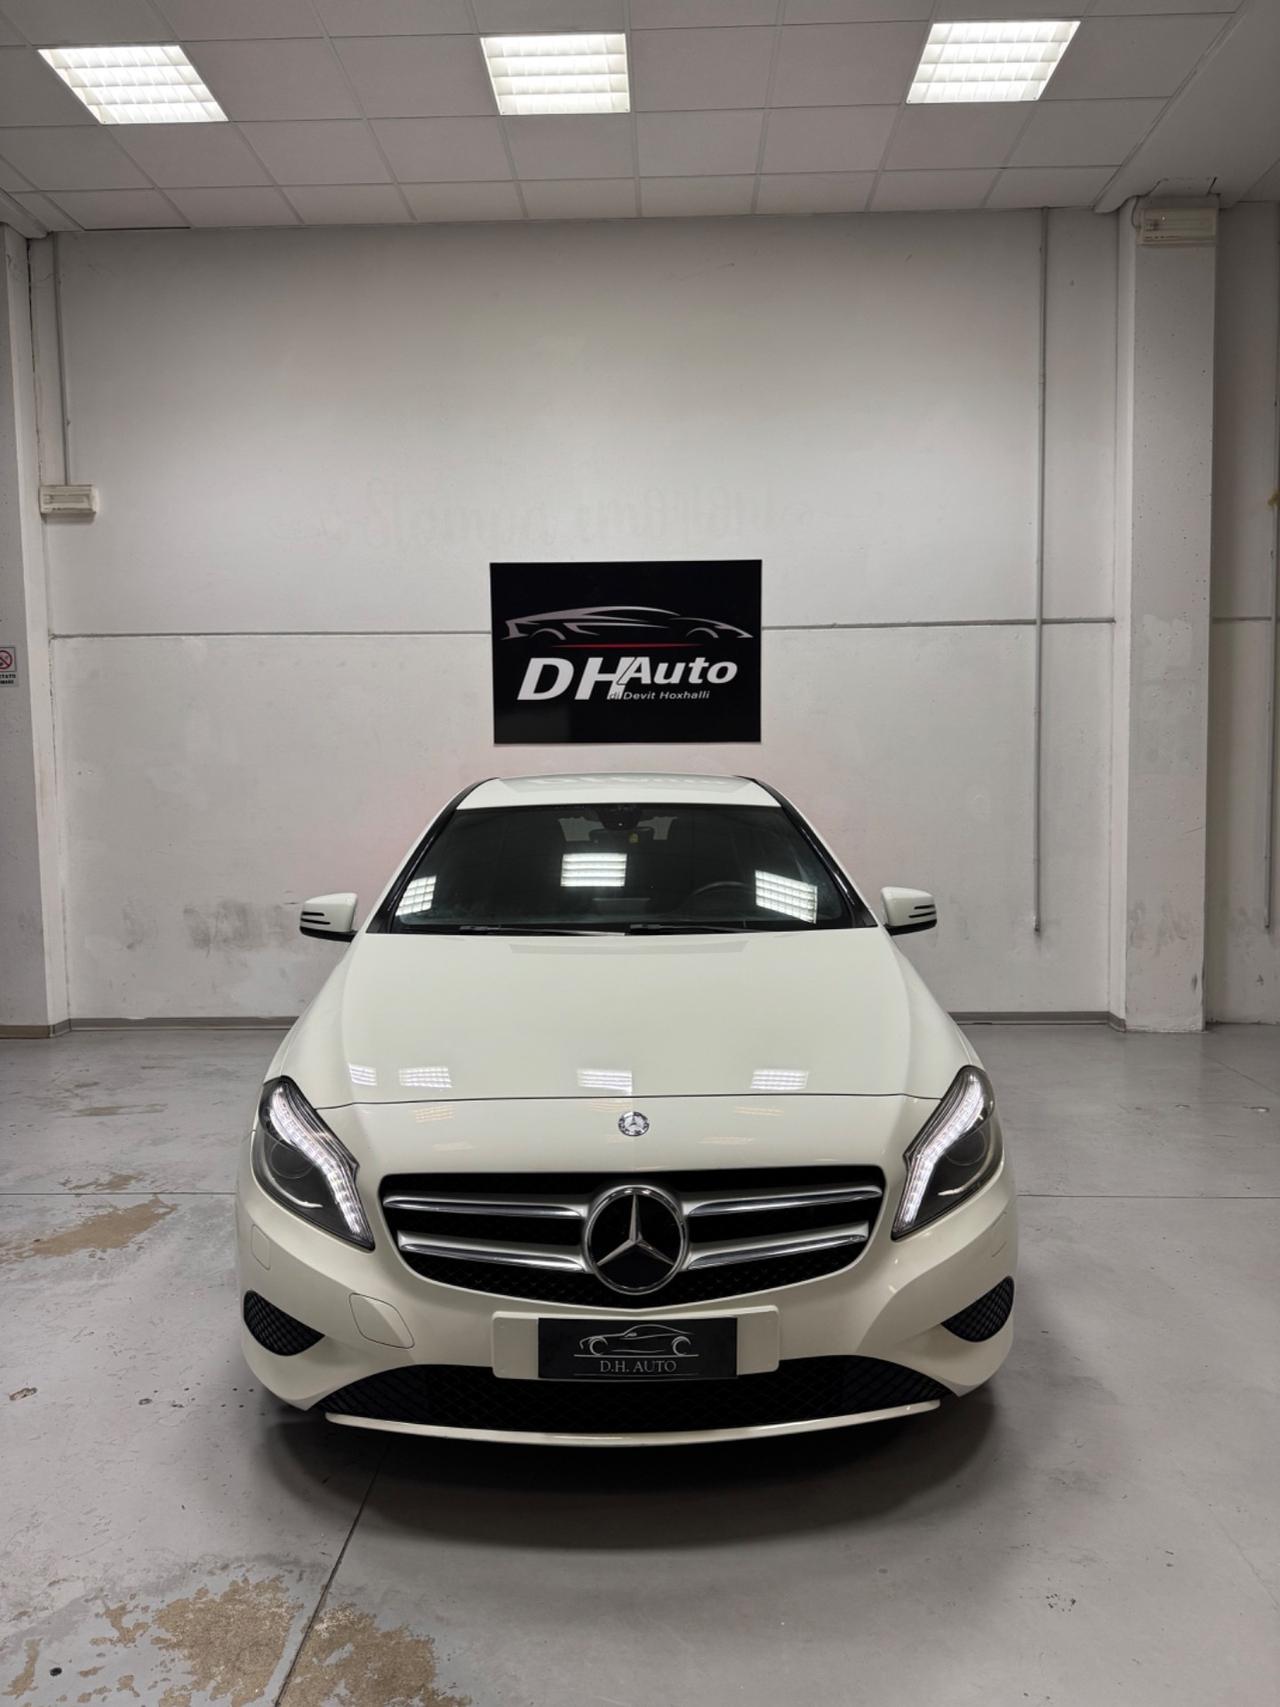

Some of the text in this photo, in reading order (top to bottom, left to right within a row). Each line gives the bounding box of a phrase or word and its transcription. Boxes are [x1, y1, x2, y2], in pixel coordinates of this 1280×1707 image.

[623, 691, 656, 700] Devit
[659, 690, 710, 700] Hoxhalli
[600, 1359, 677, 1373] D.H. AUTO
